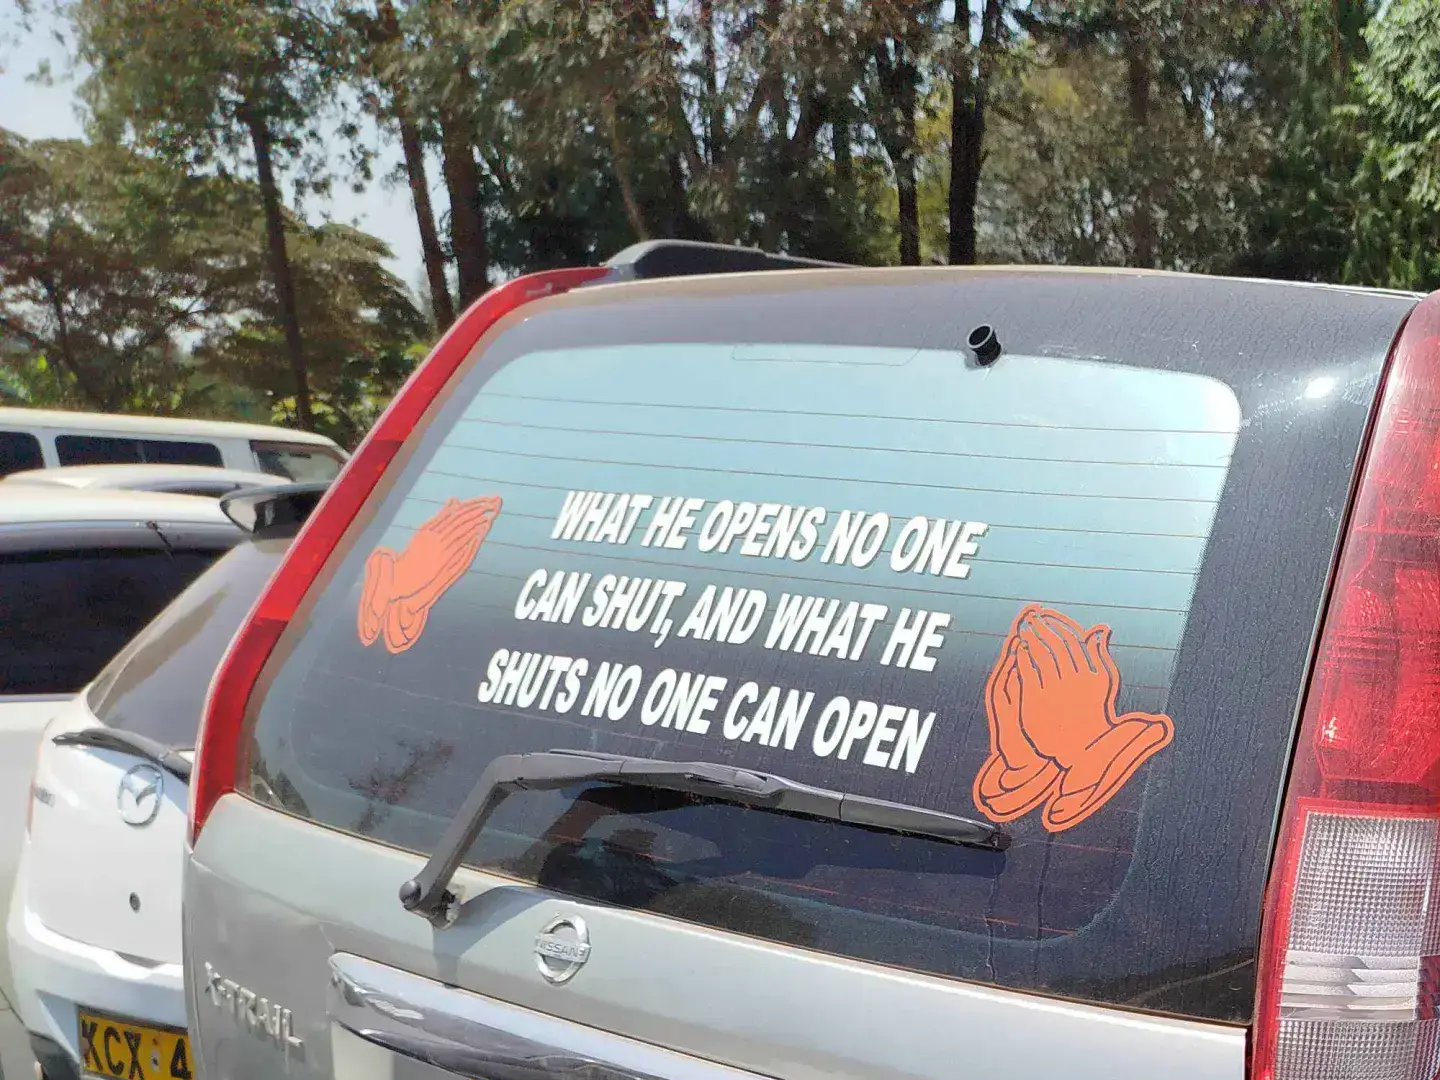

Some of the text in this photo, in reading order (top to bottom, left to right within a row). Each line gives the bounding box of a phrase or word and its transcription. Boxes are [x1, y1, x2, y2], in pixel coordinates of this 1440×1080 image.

[551, 490, 987, 580] WHAT HE OPENS NO ONE
[514, 568, 952, 673] CAN SHUT, AND WHAT HE
[477, 648, 936, 775] SHUTS NO ONE CAN OPEN
[534, 937, 579, 959] NISSAN
